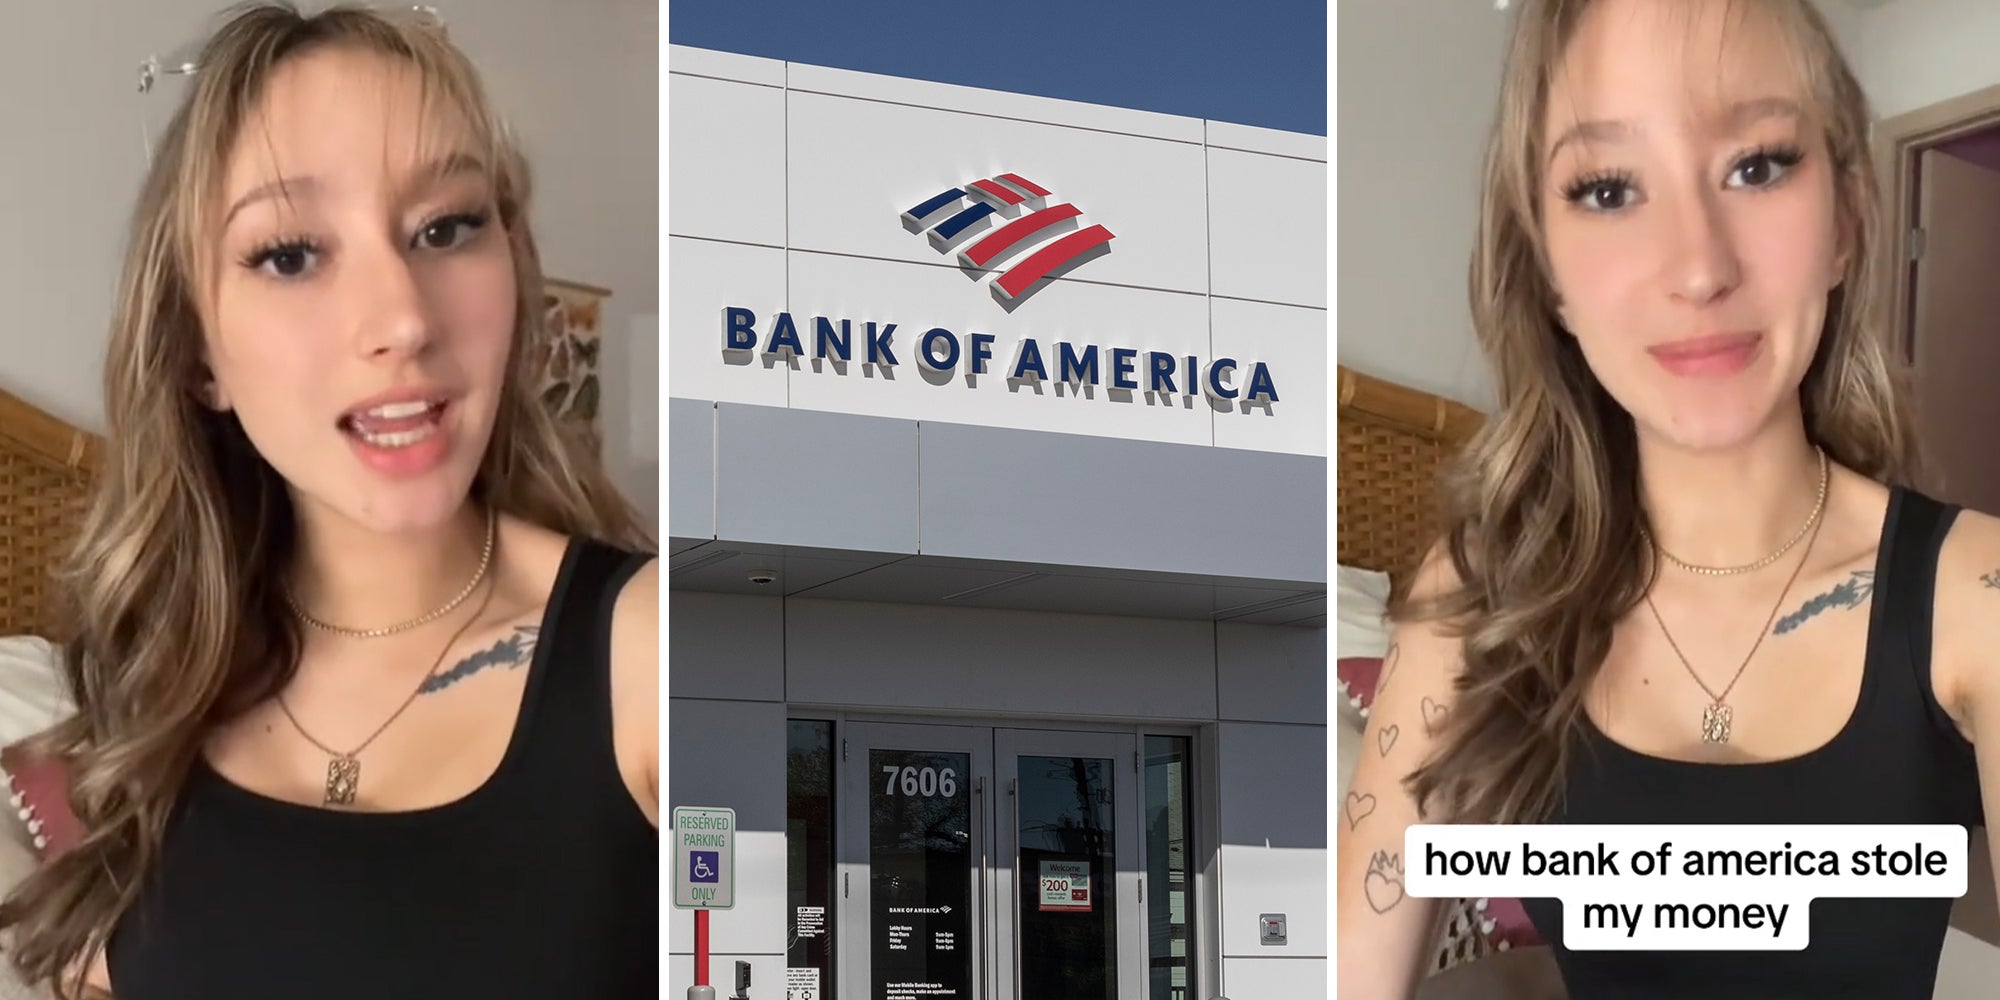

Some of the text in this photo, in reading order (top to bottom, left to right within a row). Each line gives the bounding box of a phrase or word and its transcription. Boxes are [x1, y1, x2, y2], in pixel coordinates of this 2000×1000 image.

[722, 306, 1280, 403] BANK OF AMERICA
[883, 765, 957, 798] 7606
[680, 816, 729, 831] RESERVED
[683, 833, 725, 847] PARKING
[1050, 863, 1081, 872] Welcome
[1042, 879, 1068, 892] $200
[692, 887, 717, 900] ONLY
